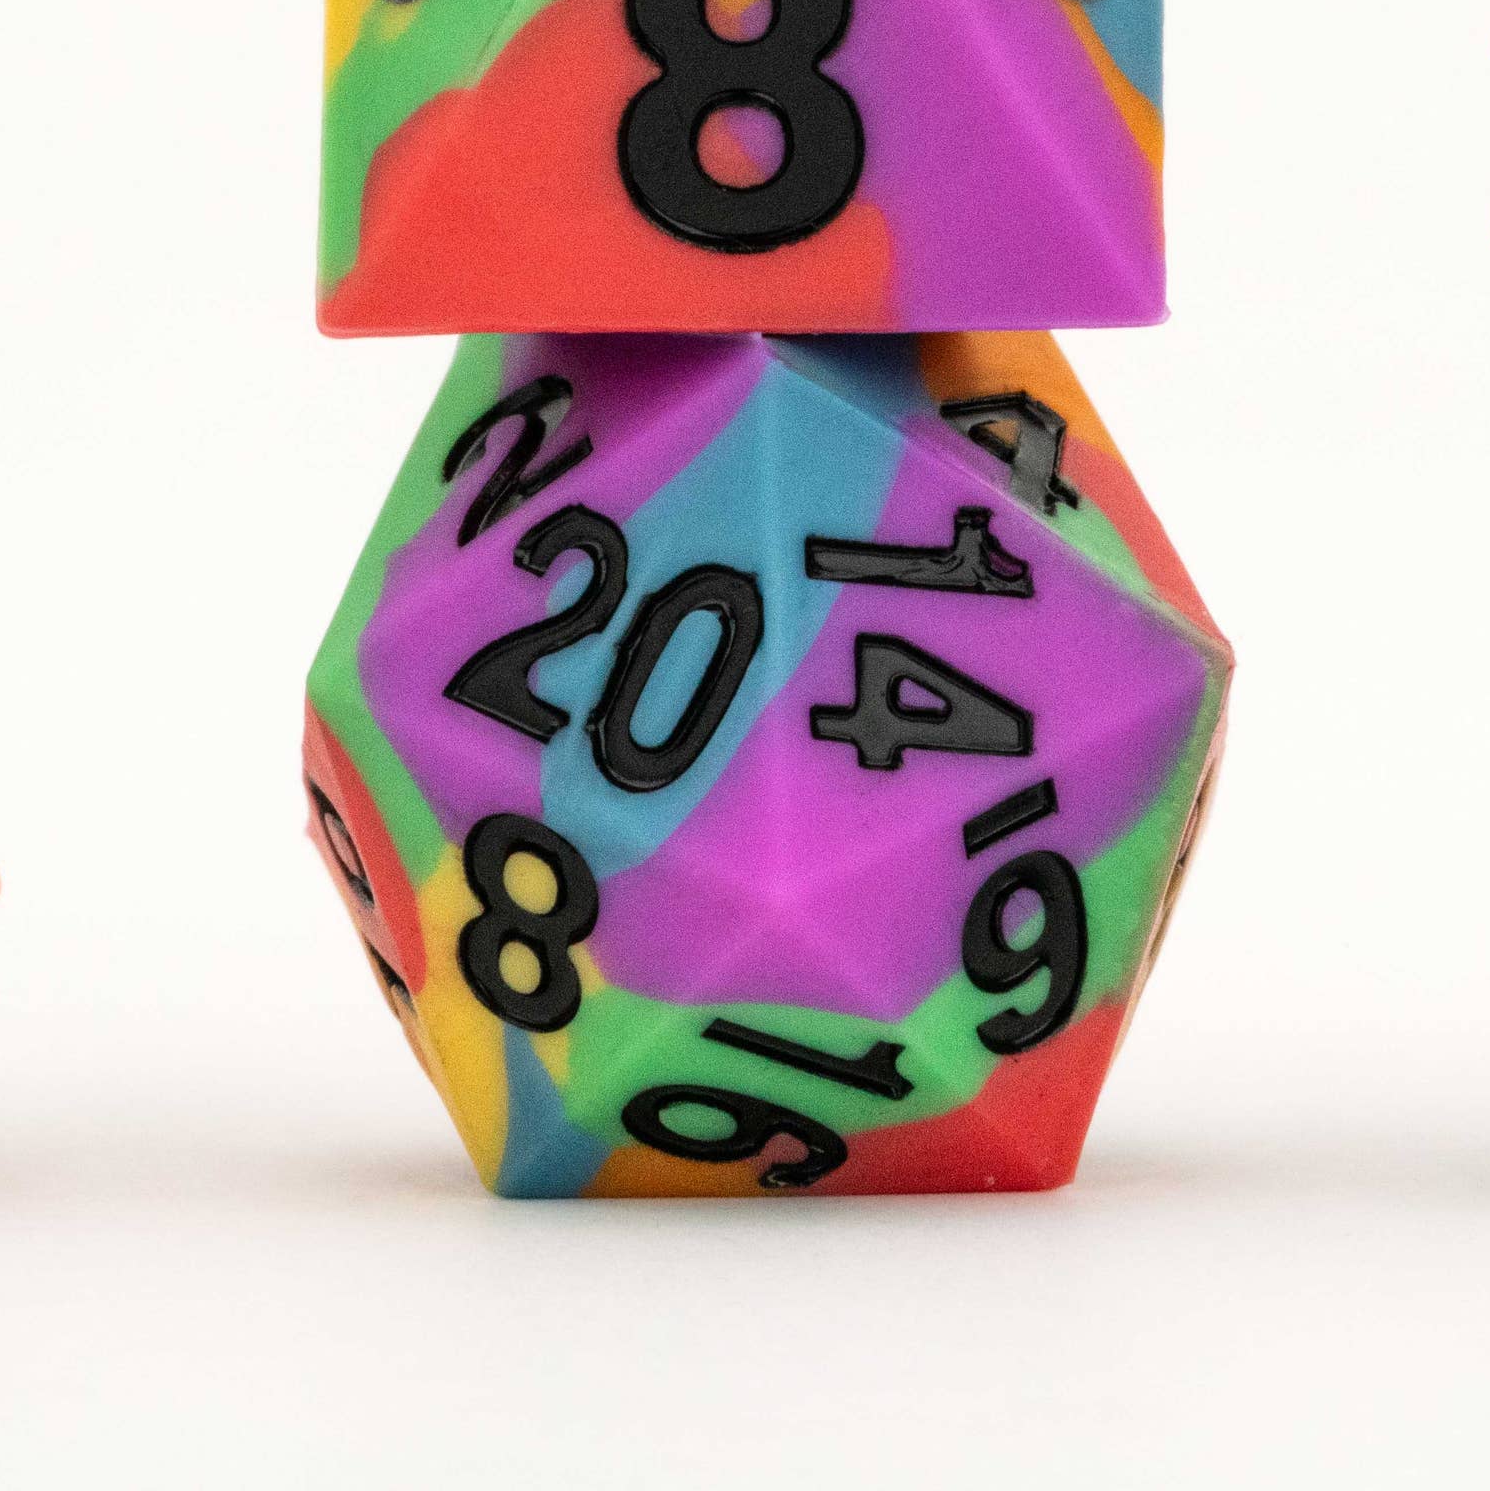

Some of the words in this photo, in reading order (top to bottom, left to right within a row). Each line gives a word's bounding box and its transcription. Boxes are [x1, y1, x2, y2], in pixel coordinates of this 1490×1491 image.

[441, 502, 766, 795] 20
[803, 504, 1036, 773] 14
[456, 811, 602, 1035] 8
[619, 1016, 916, 1189] 16
